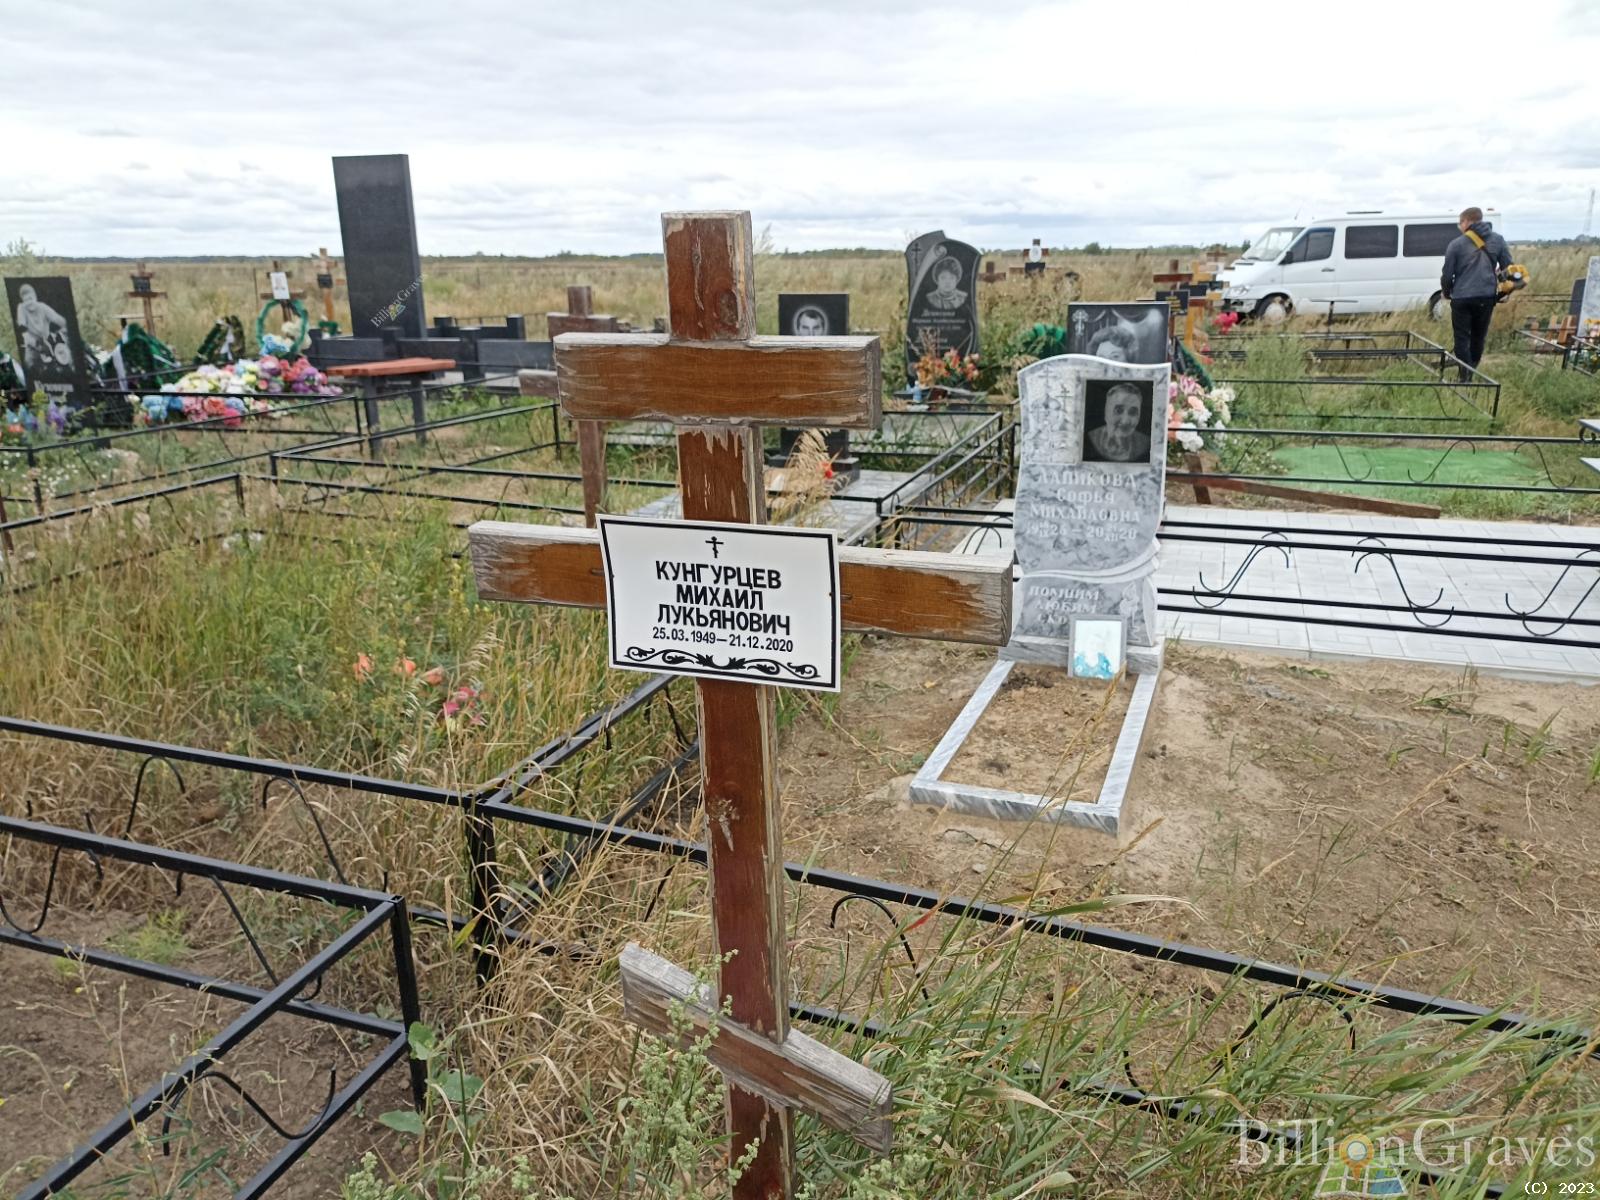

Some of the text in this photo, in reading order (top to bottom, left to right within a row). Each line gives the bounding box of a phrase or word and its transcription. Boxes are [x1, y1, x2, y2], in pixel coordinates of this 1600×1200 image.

[655, 560, 782, 590] КУНГУРЦЕВ
[676, 584, 764, 610] МИХАИЛ
[657, 603, 790, 636] ЛУКЬЯНОВИЧ
